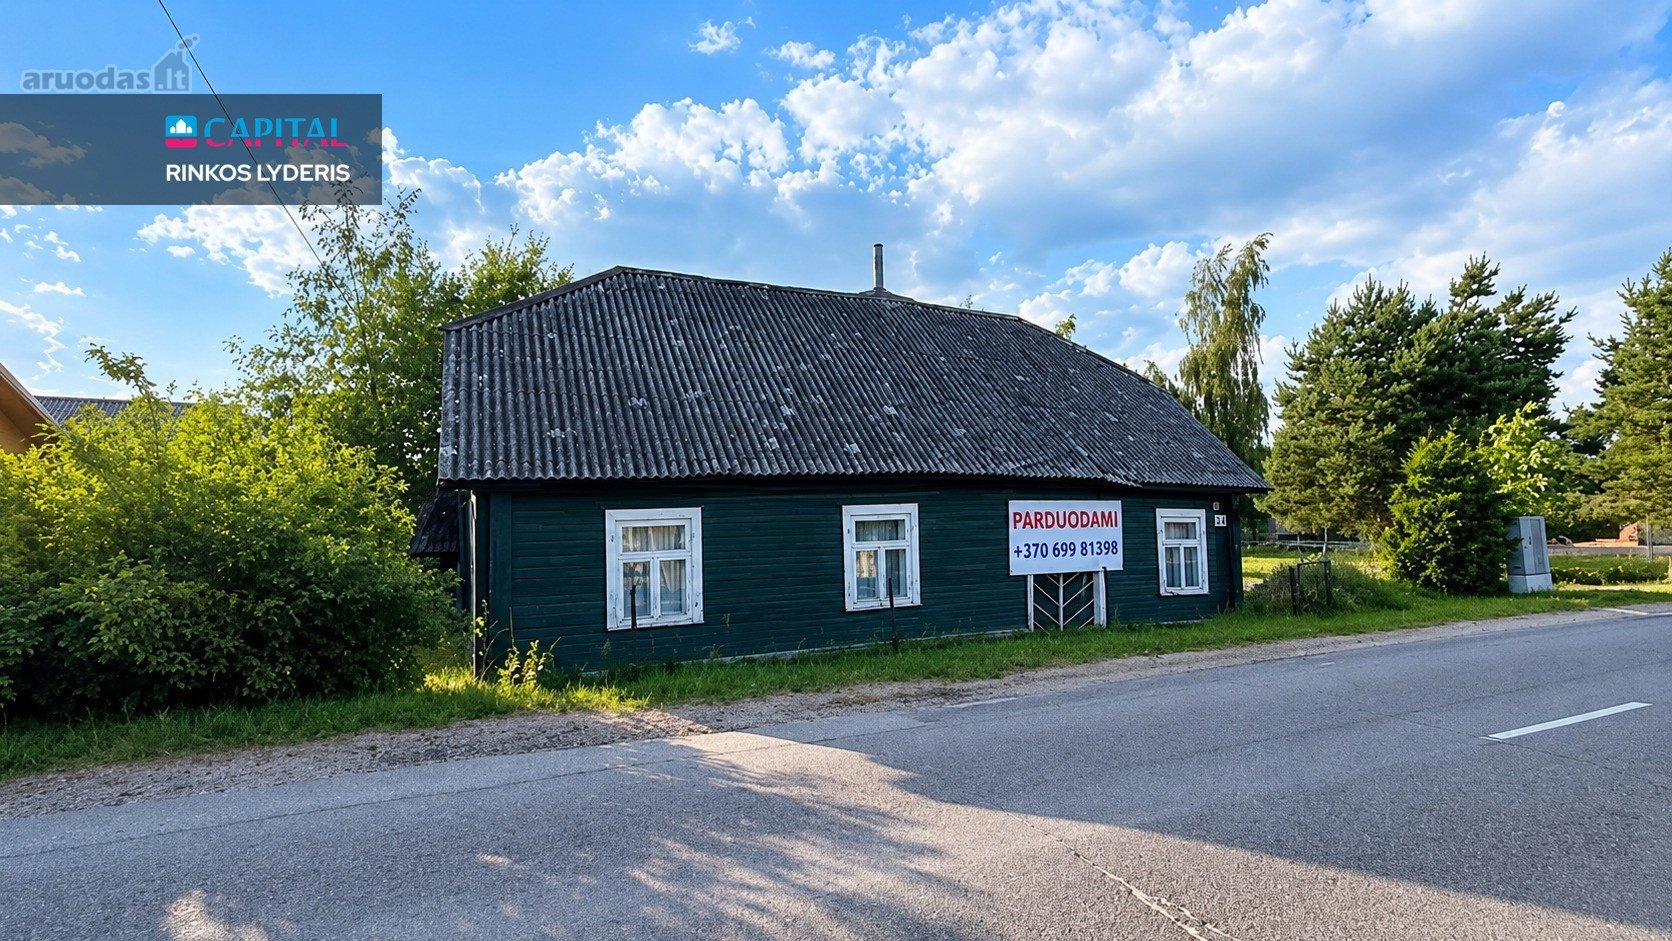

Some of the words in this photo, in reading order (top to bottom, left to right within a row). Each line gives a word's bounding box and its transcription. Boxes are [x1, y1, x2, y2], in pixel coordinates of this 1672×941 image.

[1013, 511, 1118, 529] PARDUODAMI
[1014, 542, 1049, 559] +370
[1052, 542, 1076, 558] 699
[1080, 540, 1118, 556] 81398
